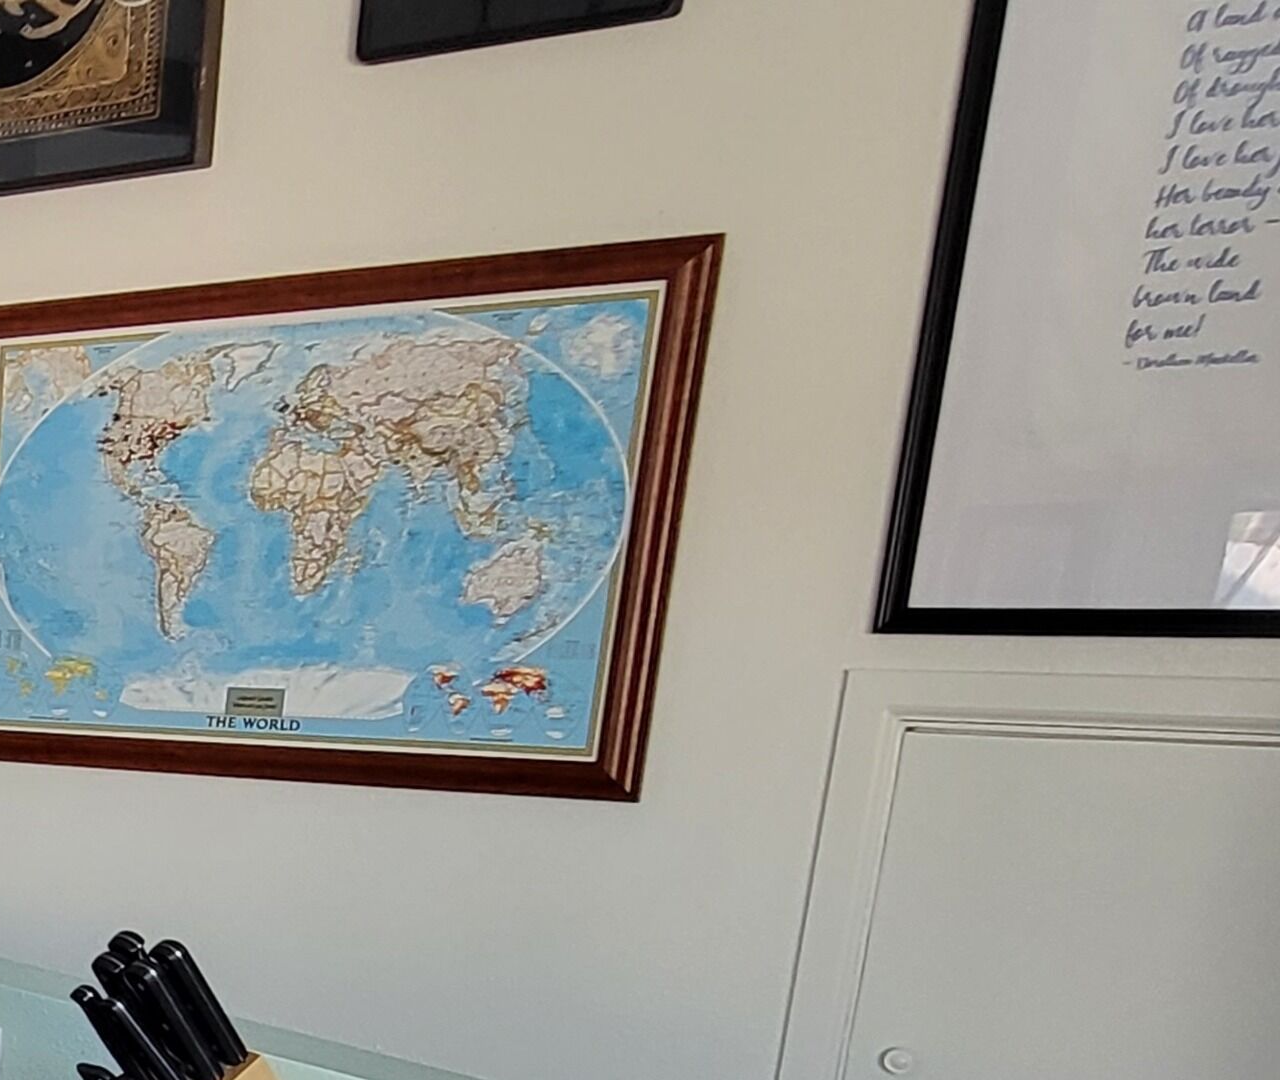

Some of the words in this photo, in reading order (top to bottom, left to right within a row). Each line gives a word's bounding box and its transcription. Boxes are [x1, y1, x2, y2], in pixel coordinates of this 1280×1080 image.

[1215, 1, 1266, 28] land
[1189, 109, 1234, 134] love
[1182, 144, 1227, 169] love
[1154, 183, 1196, 208] Her
[1201, 173, 1271, 211] beauty
[1145, 216, 1184, 239] her
[1143, 246, 1179, 274] The
[1187, 246, 1241, 269] wide
[1132, 284, 1203, 308] brown
[1208, 279, 1261, 303] land
[1125, 319, 1157, 348] for
[1162, 313, 1206, 339] me!
[206, 715, 237, 729] THE
[243, 718, 301, 731] WORLD
